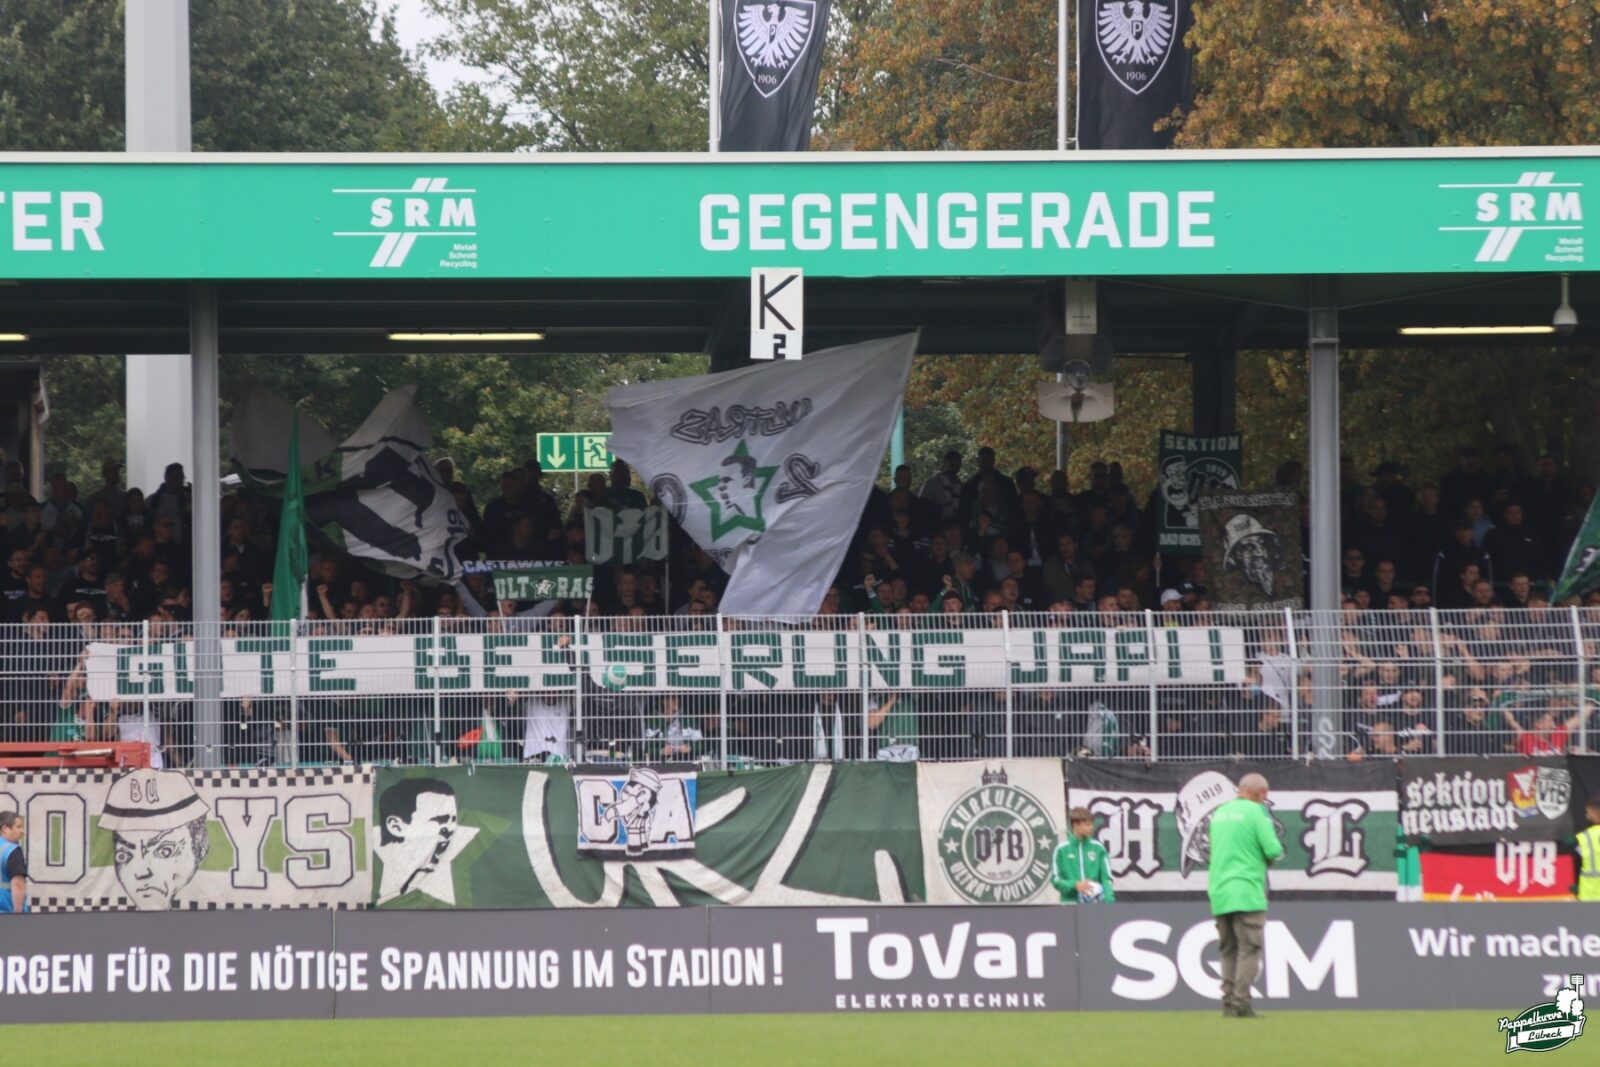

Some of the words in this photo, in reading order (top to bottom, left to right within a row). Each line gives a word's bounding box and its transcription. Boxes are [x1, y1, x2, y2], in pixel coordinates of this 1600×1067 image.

[757, 74, 777, 84] 1906
[1126, 71, 1147, 81] 1906
[0, 191, 105, 251] ER
[699, 191, 1216, 251] GEGENGERADE
[439, 260, 477, 269] Recycling
[453, 243, 477, 251] Metall
[759, 274, 799, 331] K
[772, 333, 787, 360] 2
[1163, 434, 1240, 451] SEKTION
[414, 631, 966, 690] BESSERUNG
[950, 788, 1045, 831] SUBKULTUR
[0, 792, 354, 889] OYS
[972, 826, 1025, 865] VfB
[1088, 797, 1164, 879] H
[1300, 798, 1371, 878] L
[993, 874, 1036, 902] YOUTH
[1408, 926, 1477, 957] Wir
[1486, 926, 1600, 957] mache
[0, 954, 93, 995] RGEN
[106, 946, 172, 993] FÜR
[183, 951, 238, 992] DIE
[250, 944, 369, 992] NÖTIGE
[572, 949, 615, 989] IM
[835, 992, 1047, 1009] ELEKTROTECHNIK
